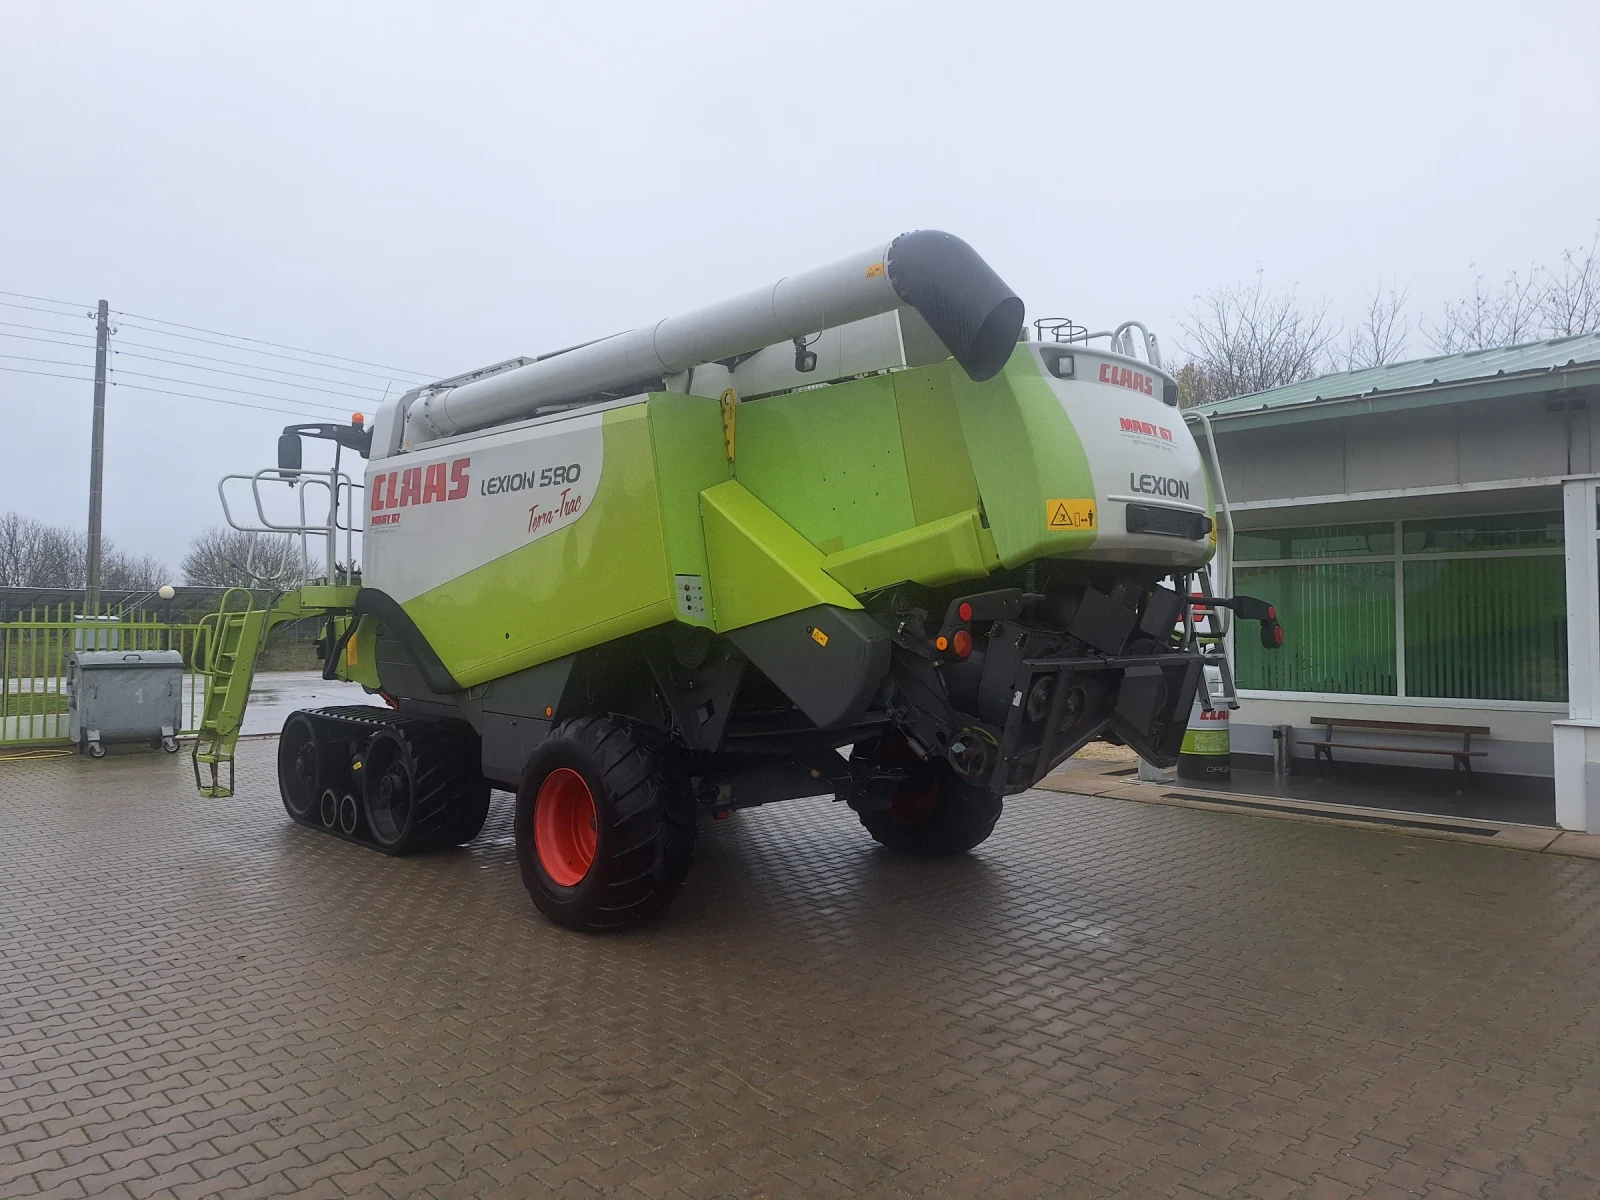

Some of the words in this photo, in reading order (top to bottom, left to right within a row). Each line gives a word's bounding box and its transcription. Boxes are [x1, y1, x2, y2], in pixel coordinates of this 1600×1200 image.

[1099, 363, 1153, 396] CLAAS
[371, 457, 471, 512] CLAAS
[480, 470, 535, 496] LEXION
[540, 463, 581, 488] 580
[1130, 472, 1190, 500] LEXION
[528, 487, 582, 534] Terra-Trac
